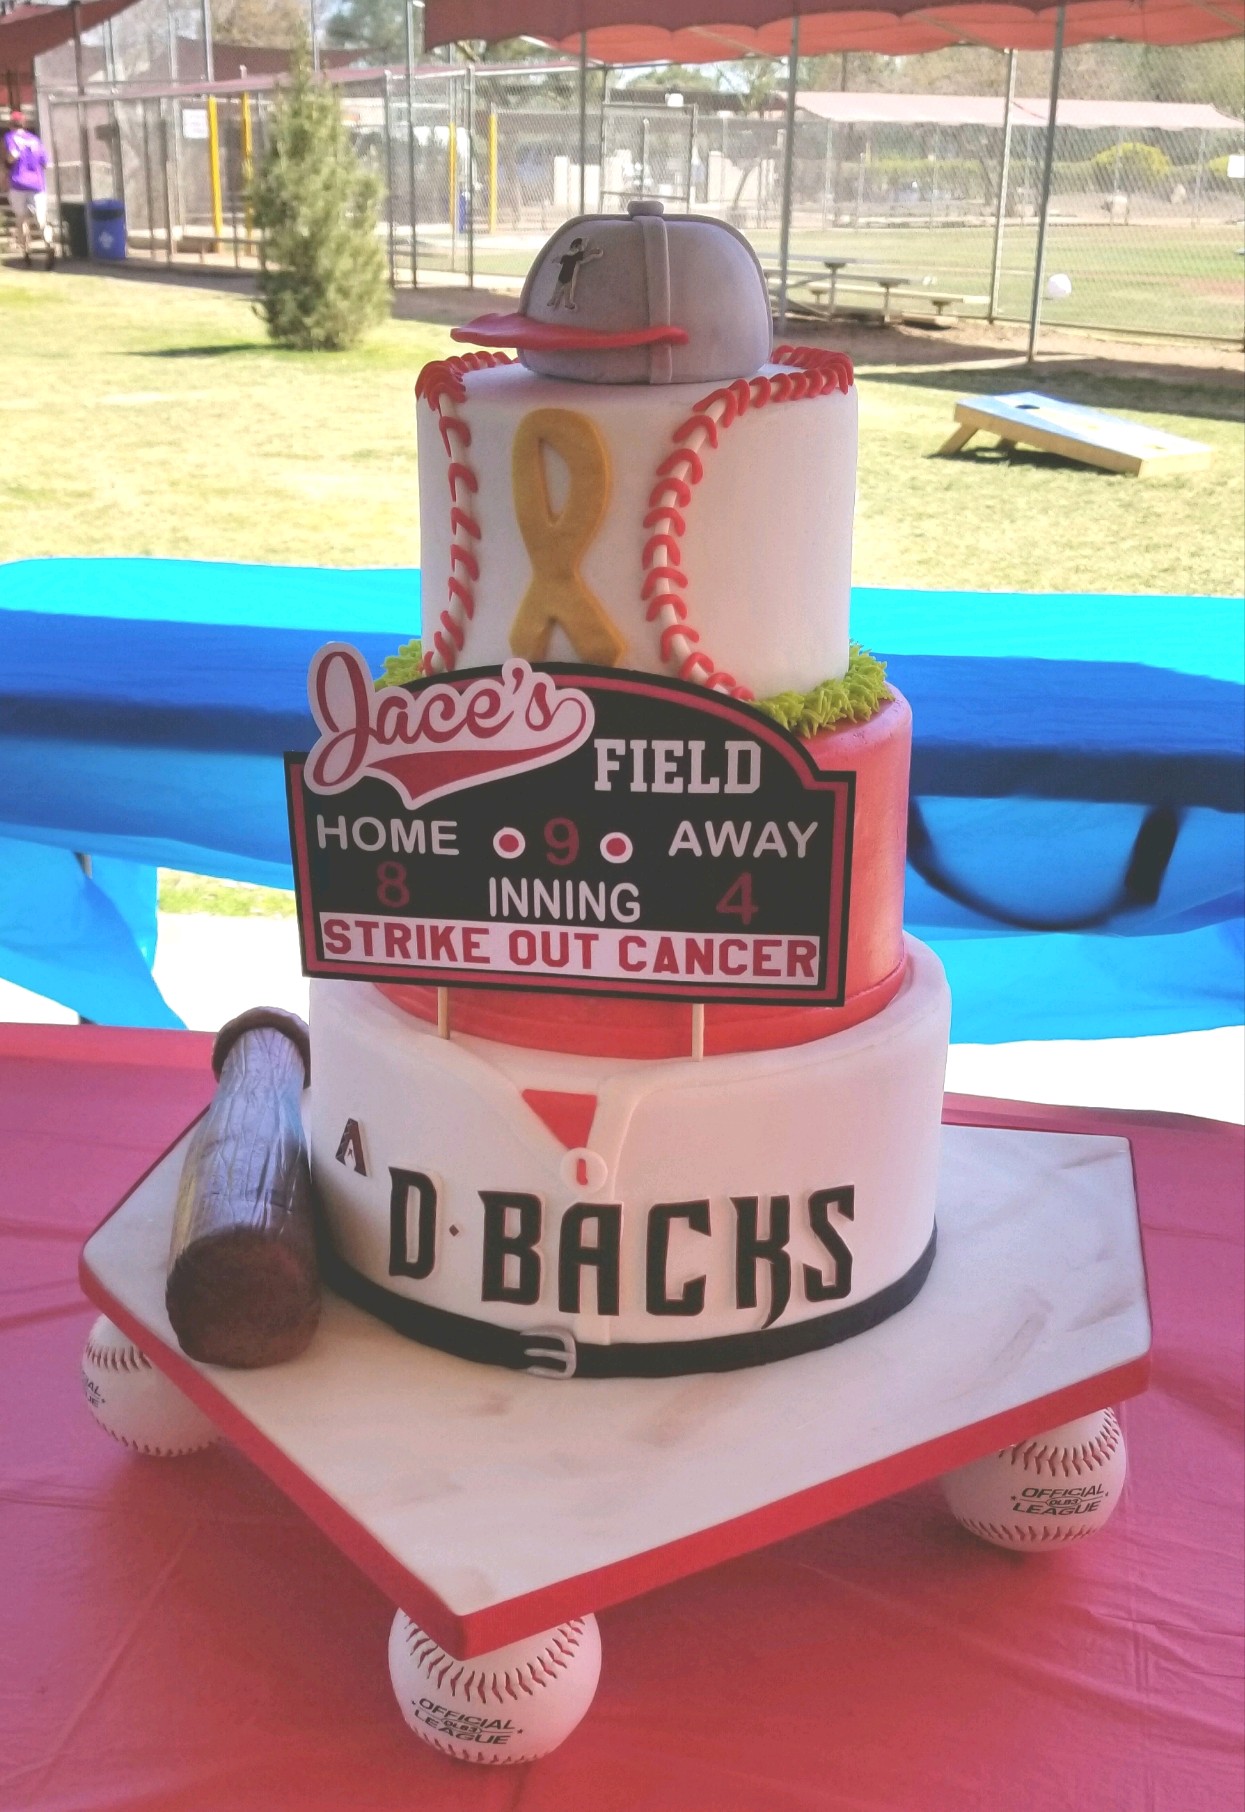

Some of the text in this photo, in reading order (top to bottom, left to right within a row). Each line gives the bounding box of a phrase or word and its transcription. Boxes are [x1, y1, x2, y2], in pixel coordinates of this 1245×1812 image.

[311, 651, 587, 787] Jace's
[594, 739, 761, 794] FIELD
[316, 815, 460, 856] HOME
[543, 818, 580, 866] 9
[668, 820, 818, 858] AWAY
[376, 861, 410, 907] 8
[488, 877, 641, 923] INNING
[715, 872, 759, 925] 4
[323, 919, 817, 977] STRIKE OUT CANCER
[1012, 1500, 1101, 1516] LEAGUE
[1021, 1483, 1104, 1498] OFFICIAL
[414, 1709, 511, 1745] LEAGUE
[419, 1698, 516, 1730] OFFICIAL
